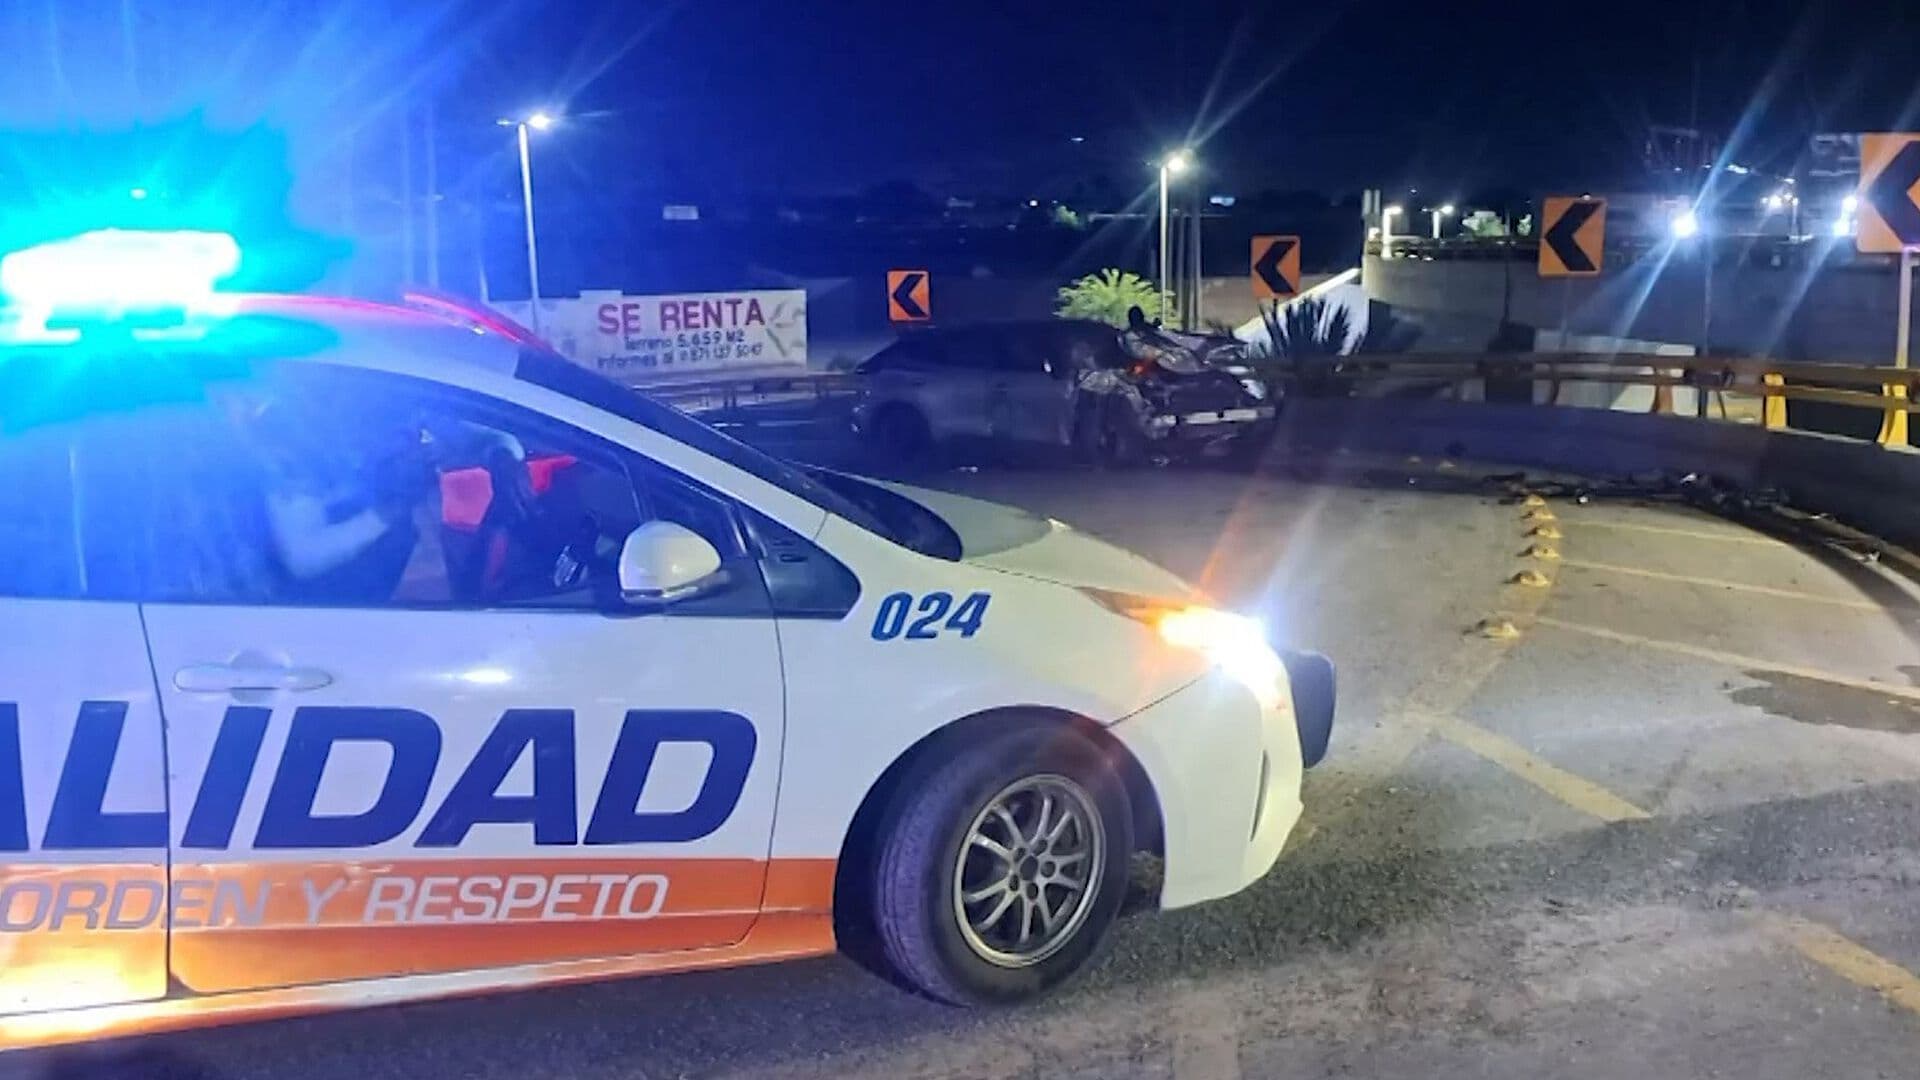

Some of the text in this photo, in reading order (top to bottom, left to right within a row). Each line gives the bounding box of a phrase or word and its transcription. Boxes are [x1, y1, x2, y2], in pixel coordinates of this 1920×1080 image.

[598, 298, 766, 334] SE RENTA
[871, 591, 991, 640] 024
[0, 700, 757, 851] LIDAD
[0, 874, 670, 932] ORDEN Y RESPETO
